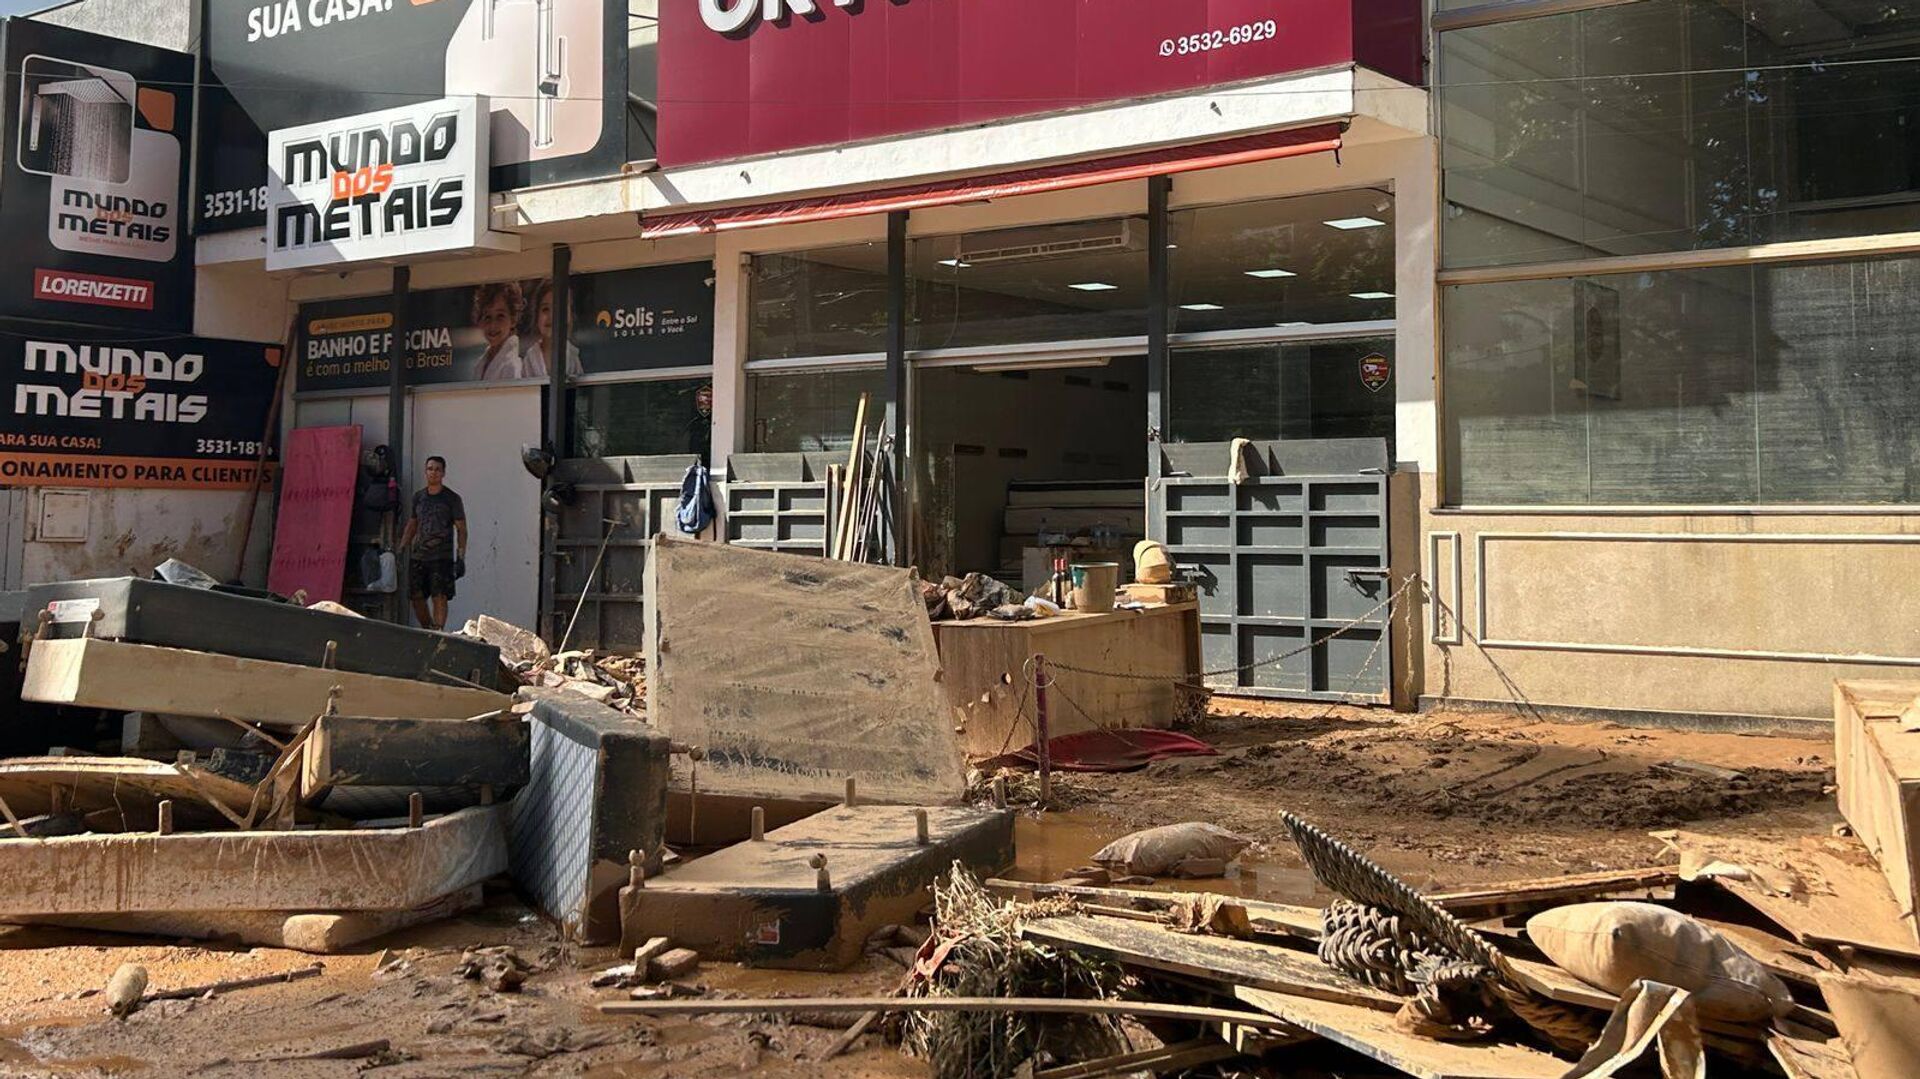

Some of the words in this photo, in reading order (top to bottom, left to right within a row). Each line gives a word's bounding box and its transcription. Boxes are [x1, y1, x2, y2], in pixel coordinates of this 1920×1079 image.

[248, 0, 301, 42] SUA
[1177, 20, 1277, 55] 3532-6929
[283, 112, 460, 188] MUNDO
[332, 163, 394, 199] DOS
[63, 189, 168, 219] MUNDO
[204, 186, 269, 219] 3531-18
[275, 176, 464, 250] METAIS
[58, 213, 170, 242] METAIS
[41, 276, 148, 302] LORENZETTI
[613, 327, 654, 338] SOLAR
[614, 306, 655, 329] Solis
[308, 335, 366, 359] BANHO
[369, 333, 381, 354] E
[383, 327, 453, 353] PCINA
[24, 340, 204, 382] MUNDO
[306, 361, 314, 377] é
[316, 362, 340, 376] com
[343, 362, 351, 374] a
[354, 356, 391, 374] melho
[417, 349, 453, 368] Brasil
[83, 371, 147, 394] DOS
[15, 384, 208, 423] METAIS
[29, 434, 57, 447] SUA
[61, 435, 102, 449] CASA!
[196, 438, 273, 455] 3531-181
[2, 461, 127, 480] ONAMENTO
[134, 464, 187, 482] PARA
